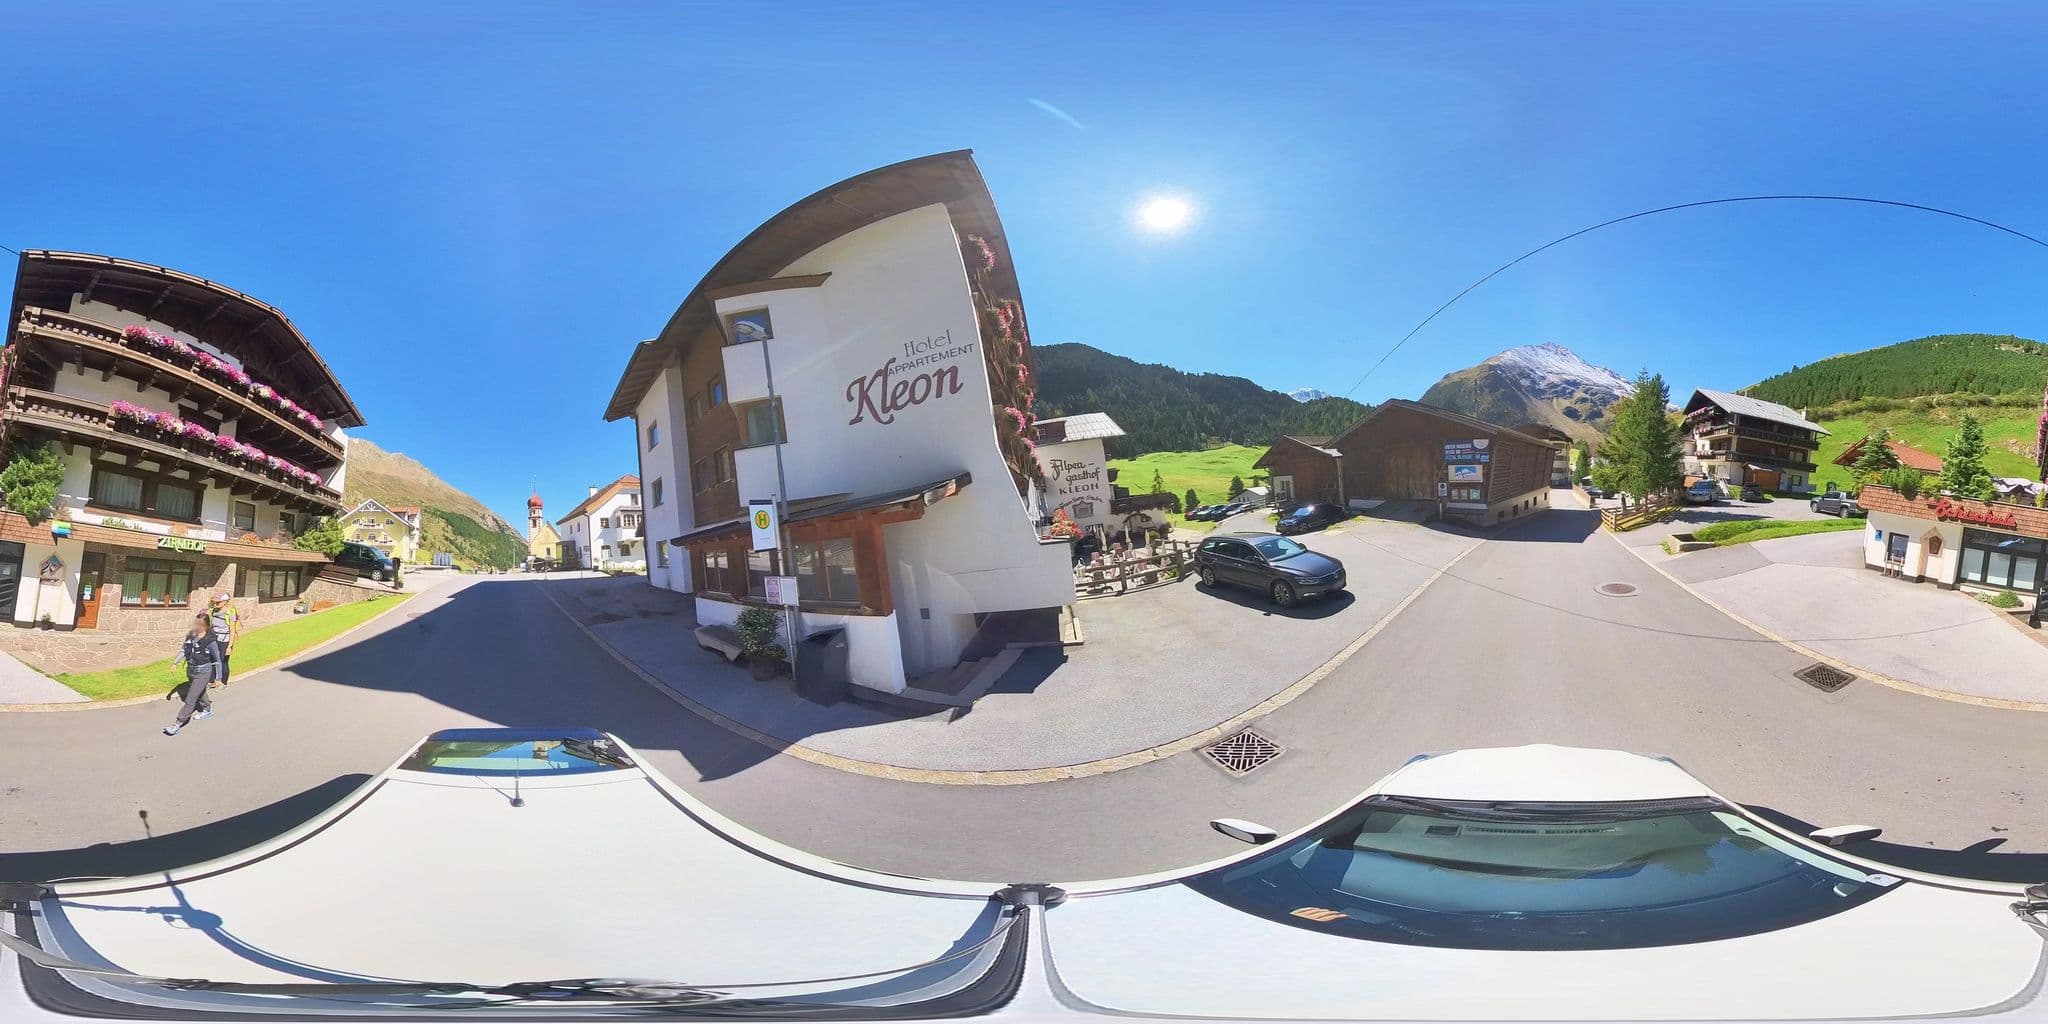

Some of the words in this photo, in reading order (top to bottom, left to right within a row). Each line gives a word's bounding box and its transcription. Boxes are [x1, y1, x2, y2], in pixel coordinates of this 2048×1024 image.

[904, 329, 952, 357] Hotel
[888, 343, 974, 377] APPARTEMENT
[846, 357, 964, 425] Kleon
[1059, 483, 1099, 495] KLEON
